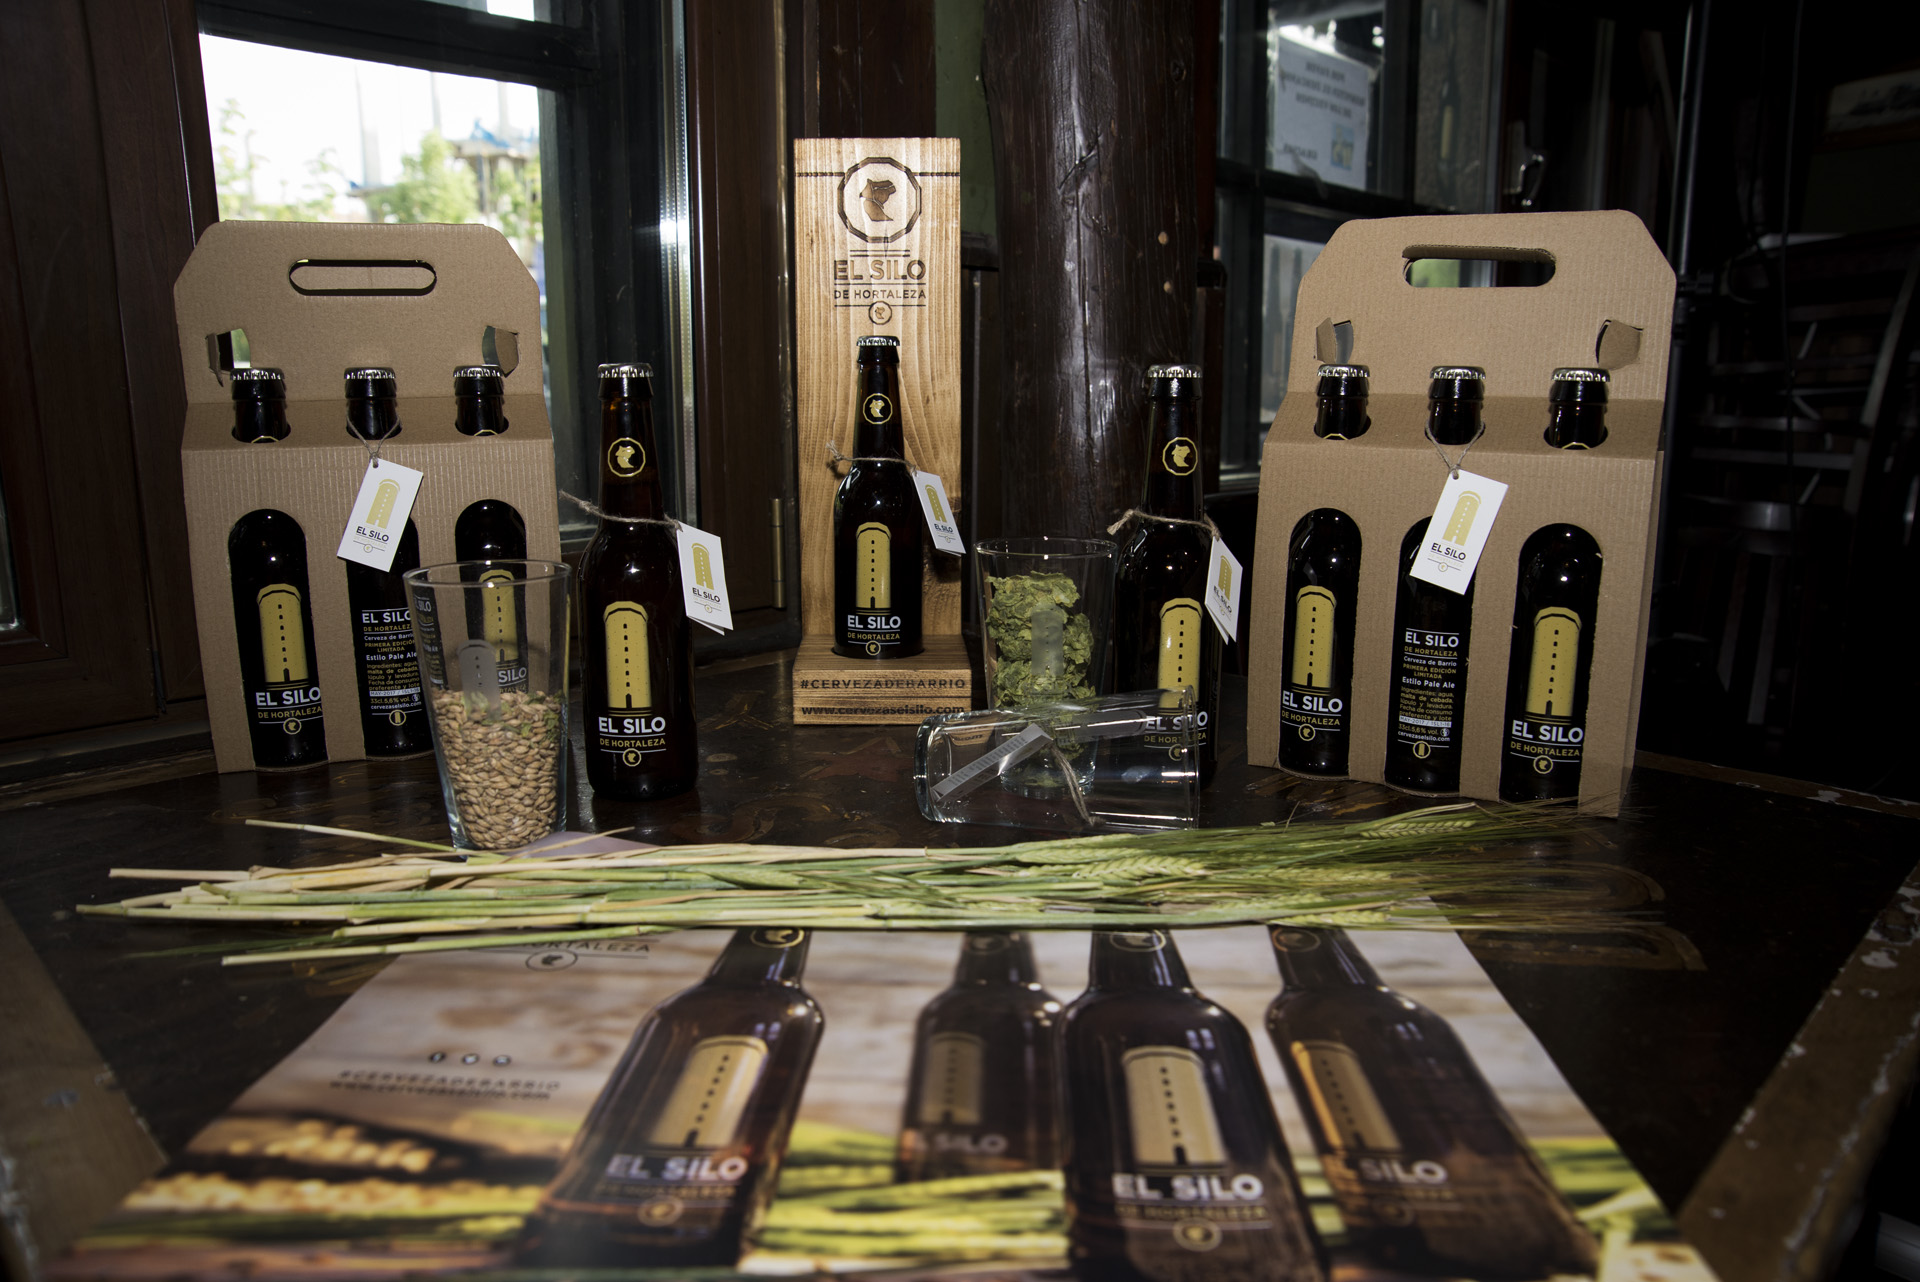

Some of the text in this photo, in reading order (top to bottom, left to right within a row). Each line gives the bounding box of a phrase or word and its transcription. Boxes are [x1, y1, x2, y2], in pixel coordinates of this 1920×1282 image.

[834, 260, 926, 280] EL SILO
[834, 290, 926, 299] DE HORTALEZA
[356, 525, 368, 536] EL
[368, 530, 390, 542] SILO
[1431, 542, 1466, 560] EL SILO
[692, 587, 702, 597] EL
[703, 591, 720, 603] SILO
[362, 612, 378, 624] EL
[848, 614, 902, 629] EL SILO
[374, 624, 412, 632] HORTALEZ
[856, 632, 900, 640] HORTALEZA
[1404, 631, 1460, 648] EL SILO
[1404, 645, 1458, 657] DE HORTALEZA
[1404, 656, 1426, 664] Cerveza
[498, 667, 527, 683] SILO
[1402, 663, 1456, 674] PRIMERA EDICIÓN
[369, 684, 402, 692] preferente
[394, 677, 420, 685] consumo
[800, 679, 966, 689] #CERVEZADEBARRIO
[1402, 676, 1422, 686] Estilo
[1424, 680, 1440, 688] Pale
[255, 686, 321, 706] EL SILO
[1282, 690, 1343, 713] EL SILO
[1400, 692, 1416, 700] malta
[270, 706, 322, 718] HORTALEZA
[1400, 704, 1416, 712] Fecha
[1426, 708, 1452, 716] consumo
[598, 716, 666, 734] EL SILO
[1146, 716, 1167, 730] EL
[1282, 710, 1341, 726] DE HORTALEZA
[1398, 731, 1450, 742] cervezaselsilo.com
[1512, 720, 1584, 743] EL SILO
[599, 738, 666, 748] DE HORTALEZA
[1510, 741, 1580, 757] DE HORTALEZA
[605, 1152, 750, 1182] EL SILO
[1359, 1157, 1449, 1186] SILO
[1111, 1172, 1264, 1201] EL SILO
